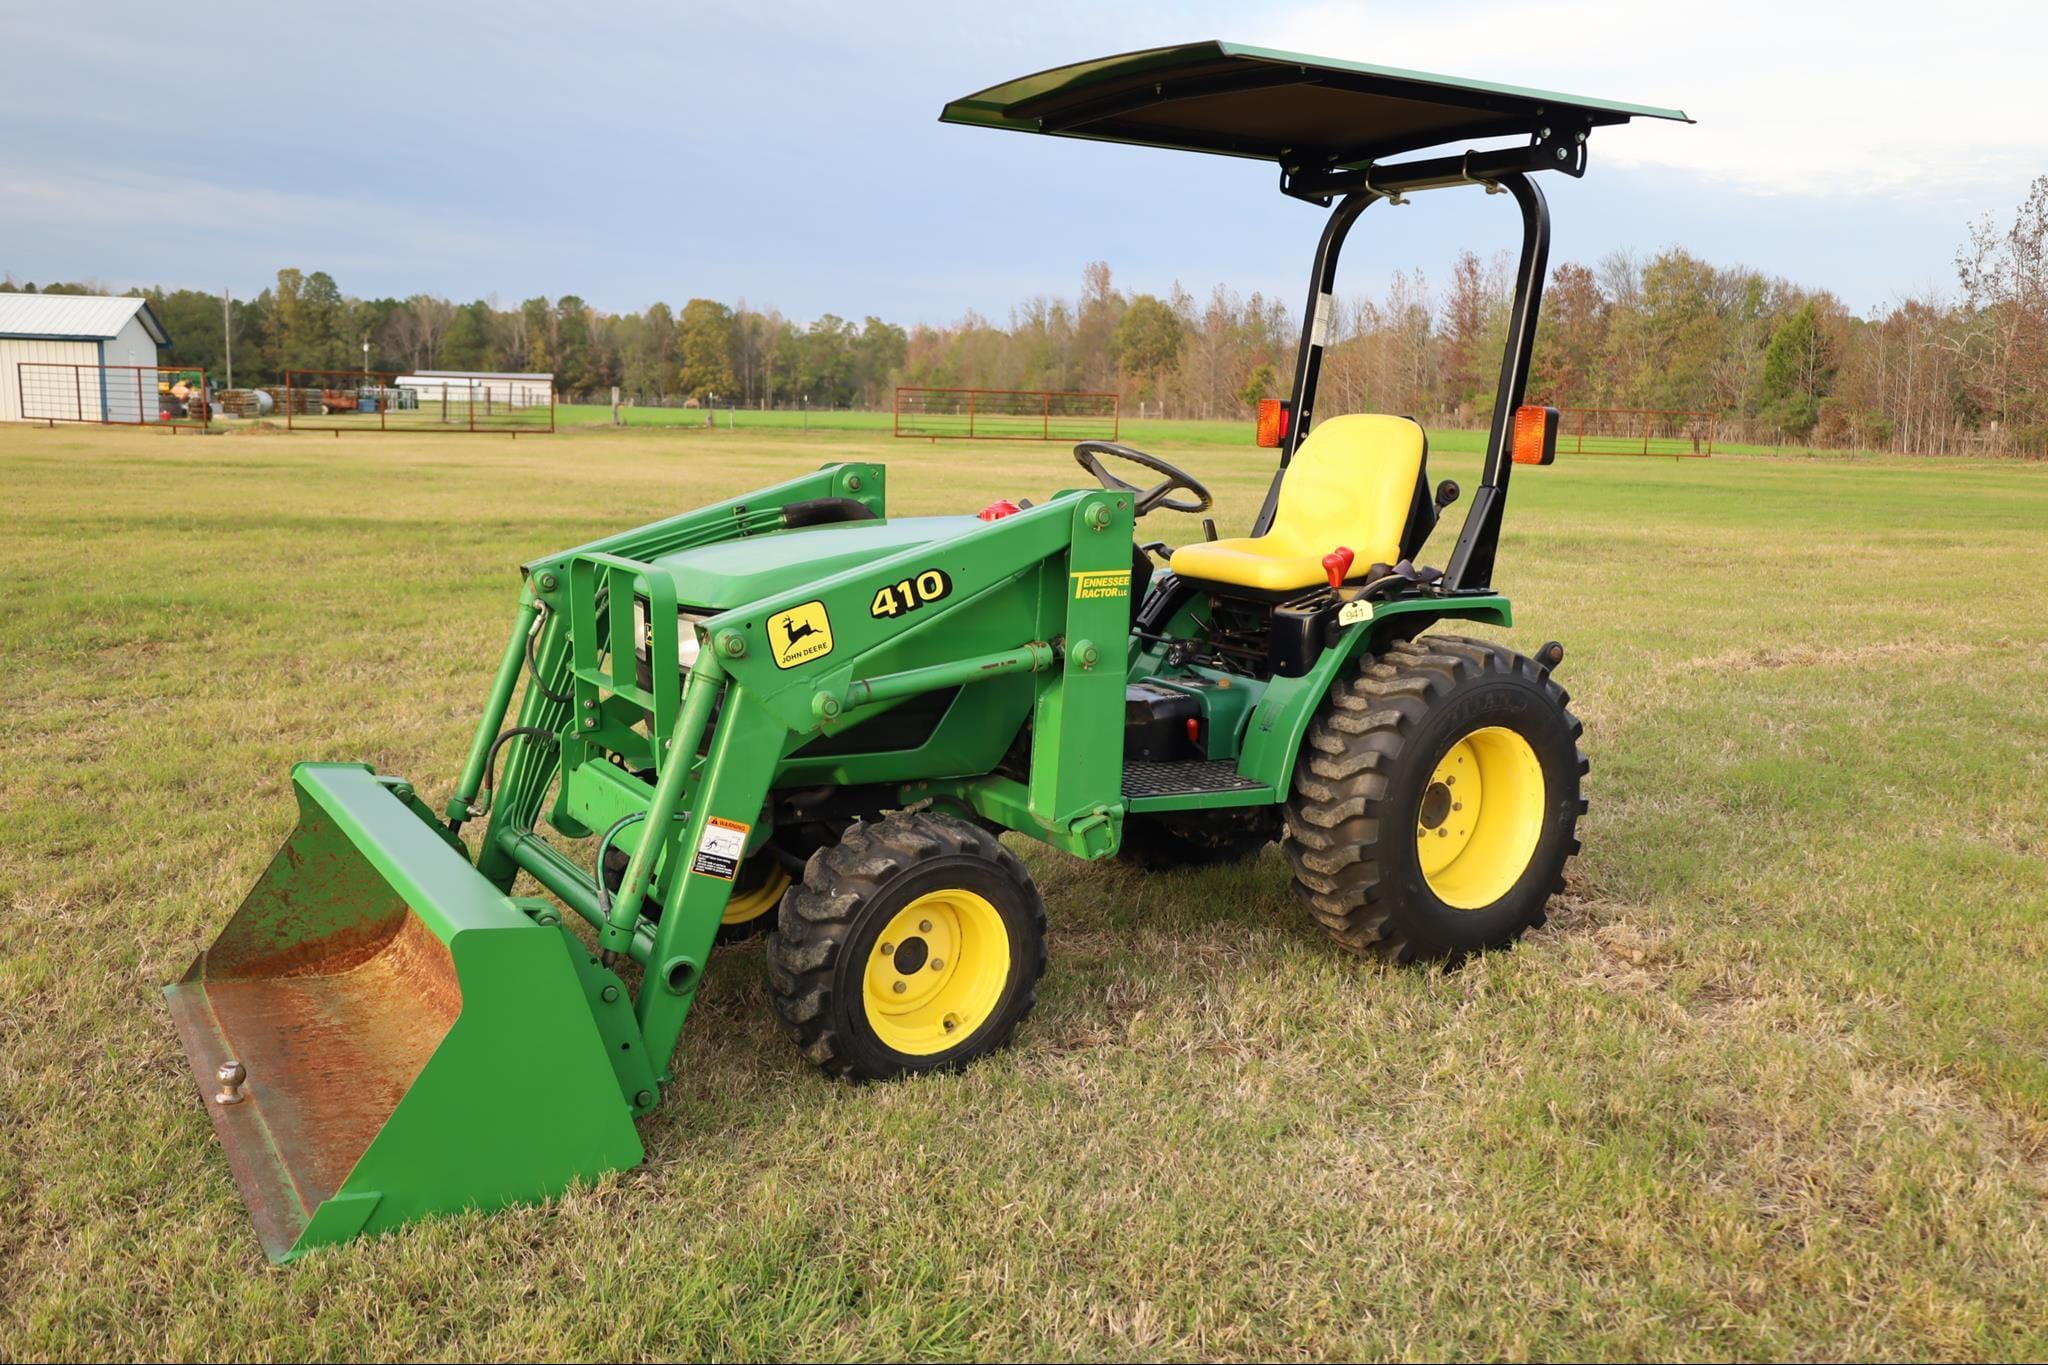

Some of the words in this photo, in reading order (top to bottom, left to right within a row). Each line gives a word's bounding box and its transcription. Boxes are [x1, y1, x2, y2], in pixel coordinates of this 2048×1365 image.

[1070, 569, 1131, 588] TENNESSEE
[870, 568, 953, 619] 410
[1345, 607, 1364, 620] 941
[781, 651, 802, 664] JOHN
[803, 641, 828, 656] DEERE
[719, 819, 746, 832] WARNING
